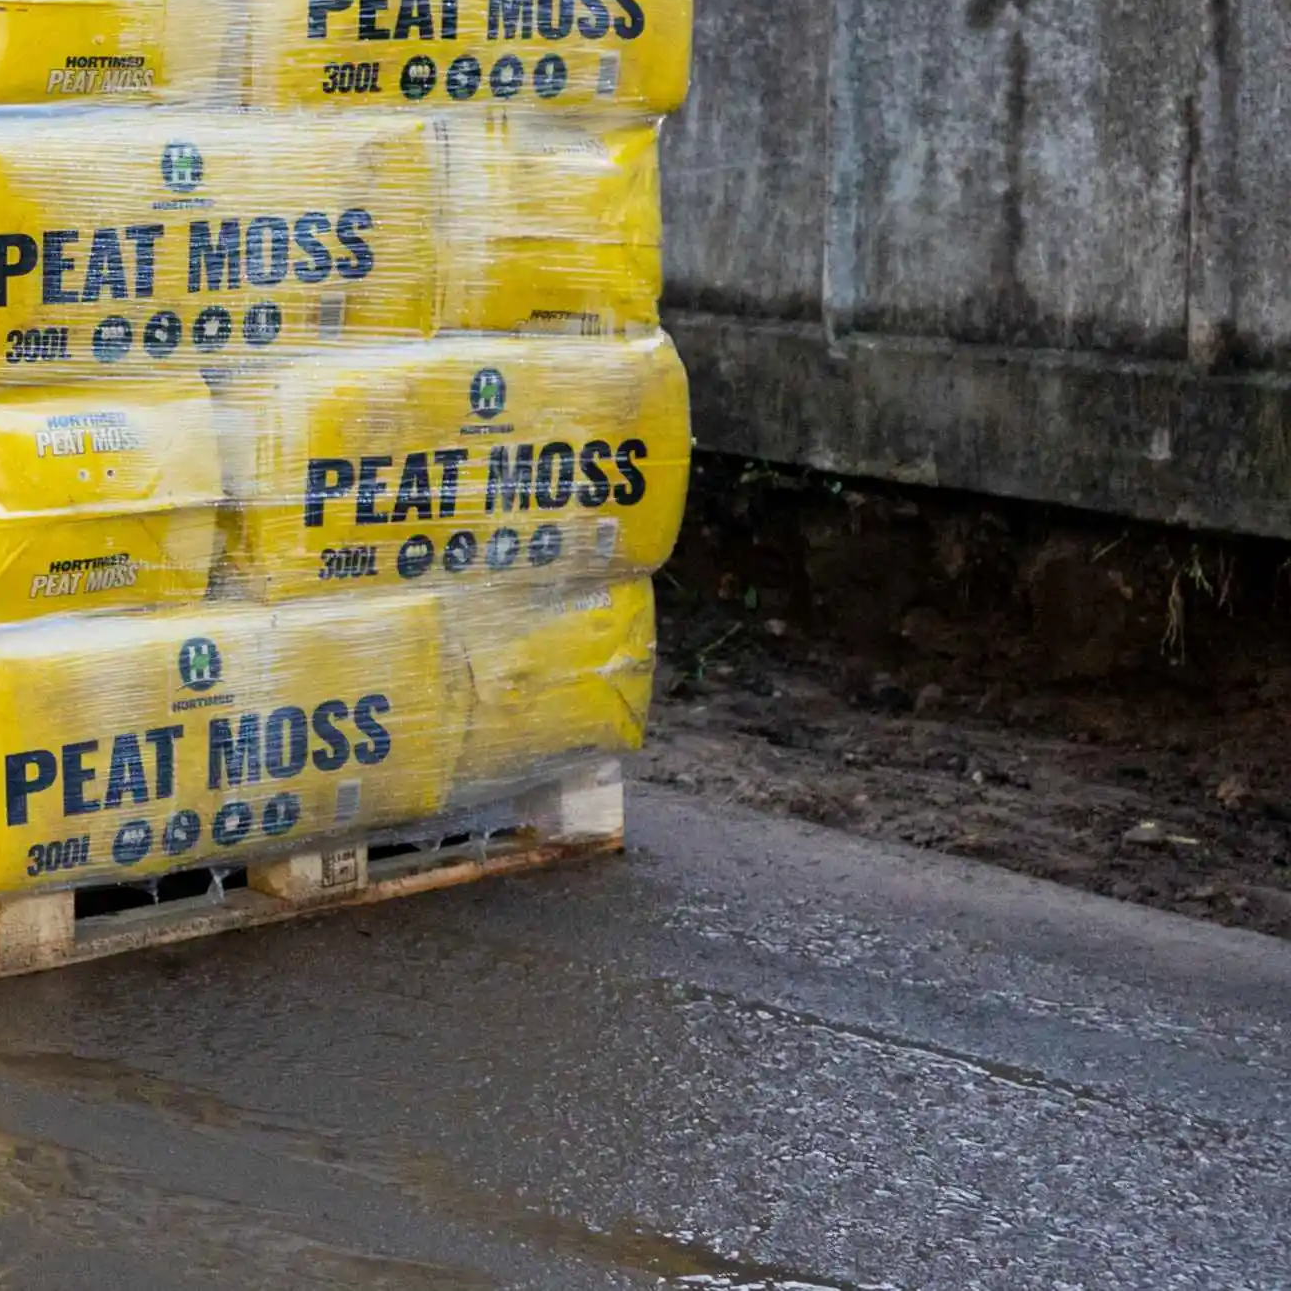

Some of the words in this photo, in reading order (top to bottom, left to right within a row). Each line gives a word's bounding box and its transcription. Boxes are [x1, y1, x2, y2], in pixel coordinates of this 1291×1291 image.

[47, 69, 99, 95] PEAT
[322, 62, 382, 95] 300L
[188, 208, 375, 293] MOSS
[6, 327, 72, 363] 300L
[37, 428, 86, 458] PEAT
[304, 449, 468, 528] PEAT
[485, 438, 647, 515] MOSS
[30, 571, 82, 598] PEAT
[84, 562, 139, 594] MOSS
[5, 724, 184, 826] PEAT
[208, 694, 392, 790] MOSS
